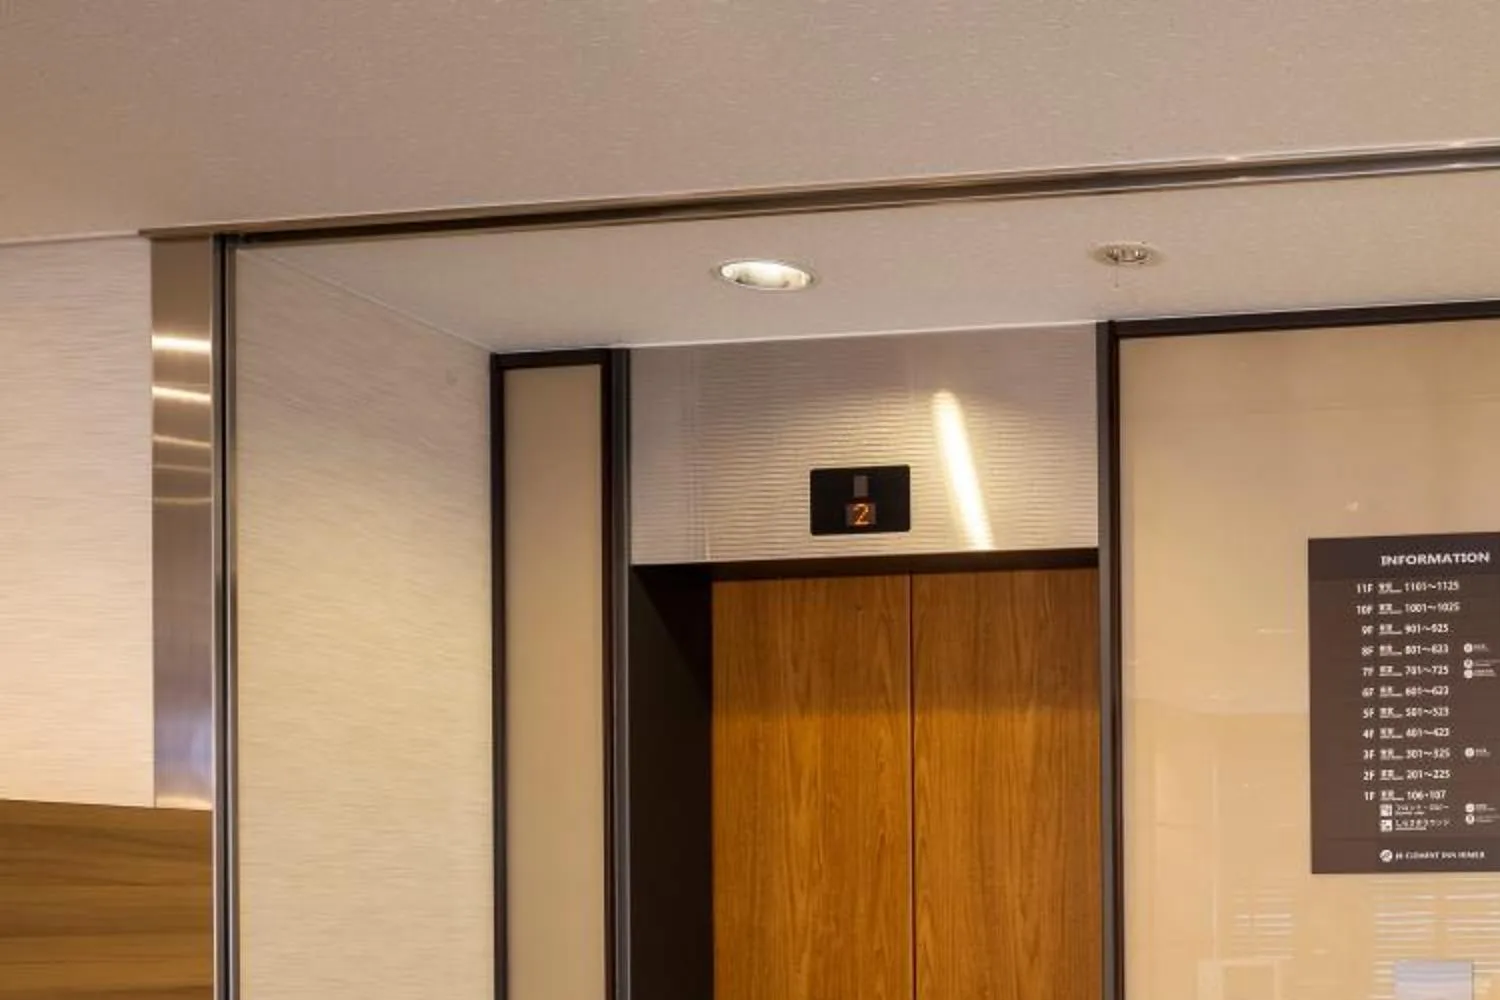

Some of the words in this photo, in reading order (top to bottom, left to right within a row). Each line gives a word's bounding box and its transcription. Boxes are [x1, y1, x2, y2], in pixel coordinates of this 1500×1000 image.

[853, 503, 869, 525] 2
[1380, 552, 1490, 566] INFORMATION
[1356, 583, 1374, 593] 11F
[1356, 605, 1373, 615] 10F
[1362, 708, 1374, 718] 5F
[1362, 729, 1374, 739] 4F
[1363, 750, 1375, 760] 3F
[1363, 770, 1375, 780] 2F
[1364, 791, 1376, 801] 1F
